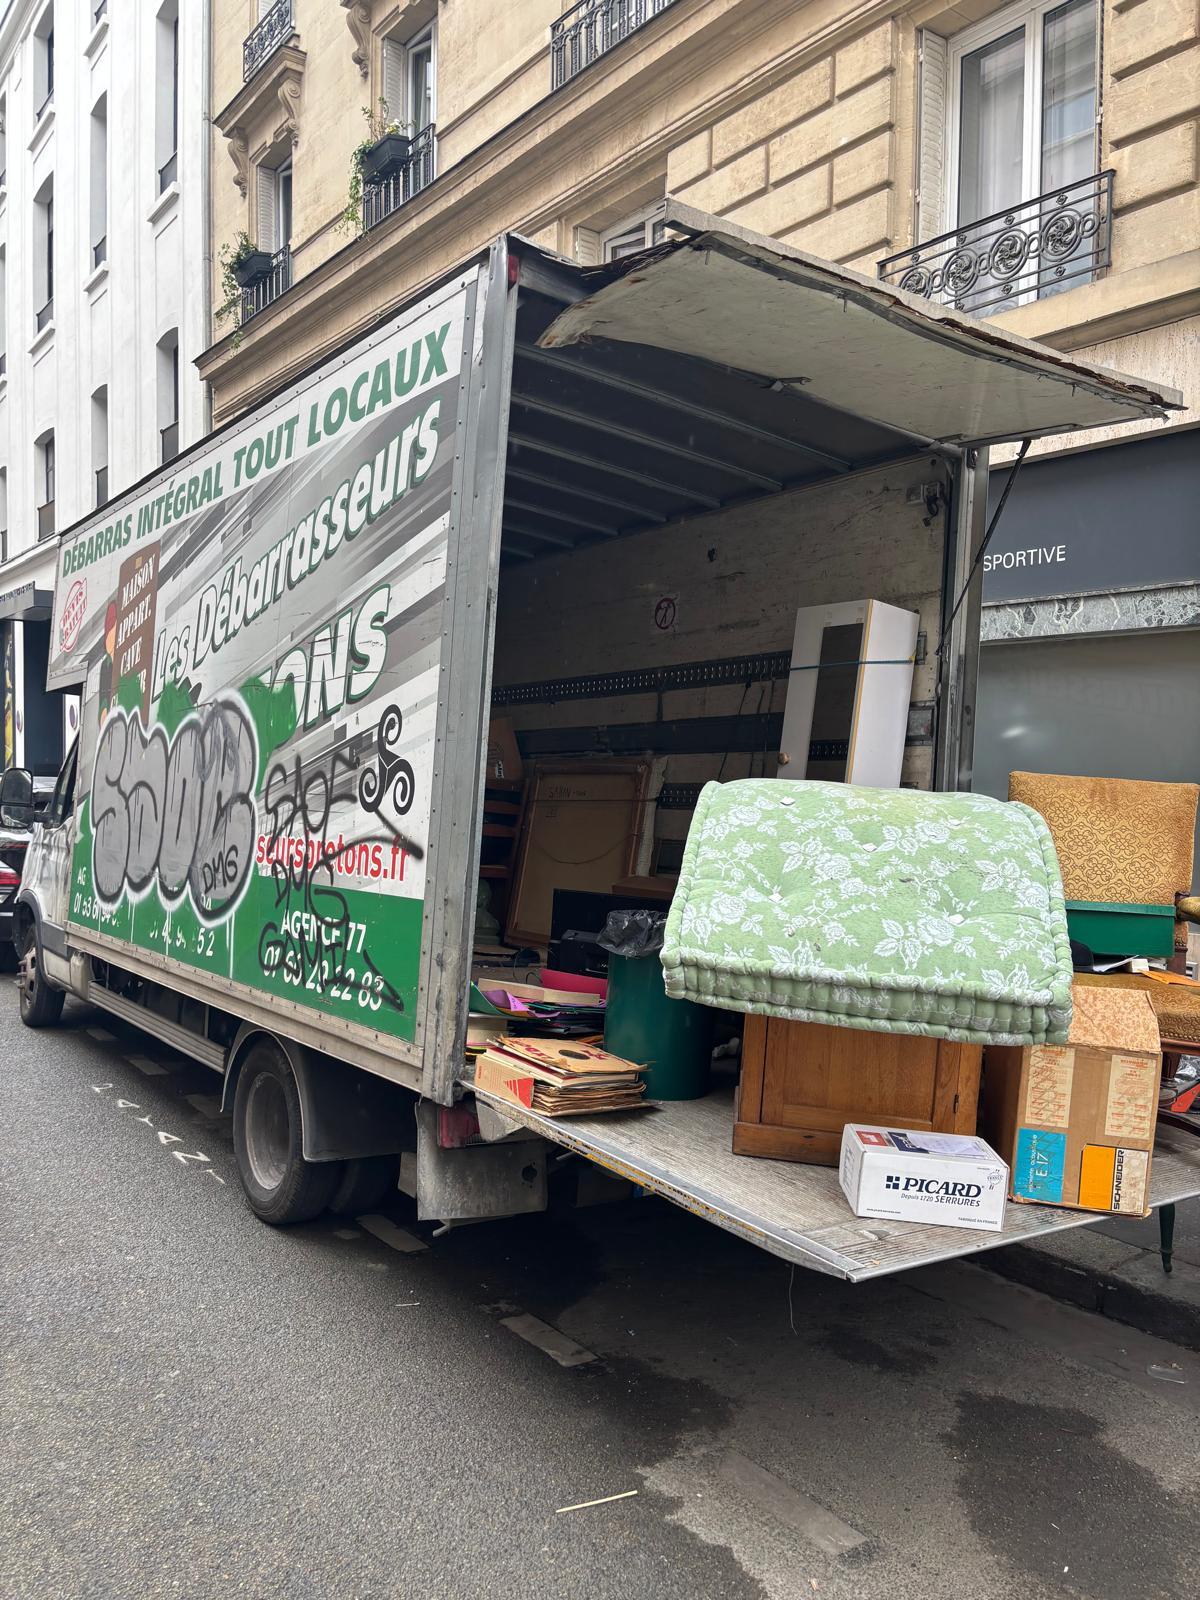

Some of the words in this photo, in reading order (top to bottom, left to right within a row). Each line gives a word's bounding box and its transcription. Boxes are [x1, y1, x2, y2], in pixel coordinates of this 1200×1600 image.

[63, 514, 132, 578] DÉBARRAS
[137, 460, 224, 538] INTÉGRAL
[234, 416, 299, 488] TOUT
[307, 321, 452, 448] LOCAUX
[151, 626, 191, 703] Les
[193, 398, 442, 671] Débarrasseurs
[983, 544, 1066, 571] SPORTIVE
[121, 554, 155, 611] MAISON
[116, 594, 152, 649] APPART.
[121, 636, 142, 675] CAVE
[280, 910, 341, 946] AGENCE
[346, 922, 367, 954] 77
[264, 946, 280, 978] 01
[358, 972, 384, 1011] 83
[901, 1193, 919, 1201] Depuis
[934, 1195, 981, 1207] SERRURES
[902, 1176, 982, 1198] PICARD
